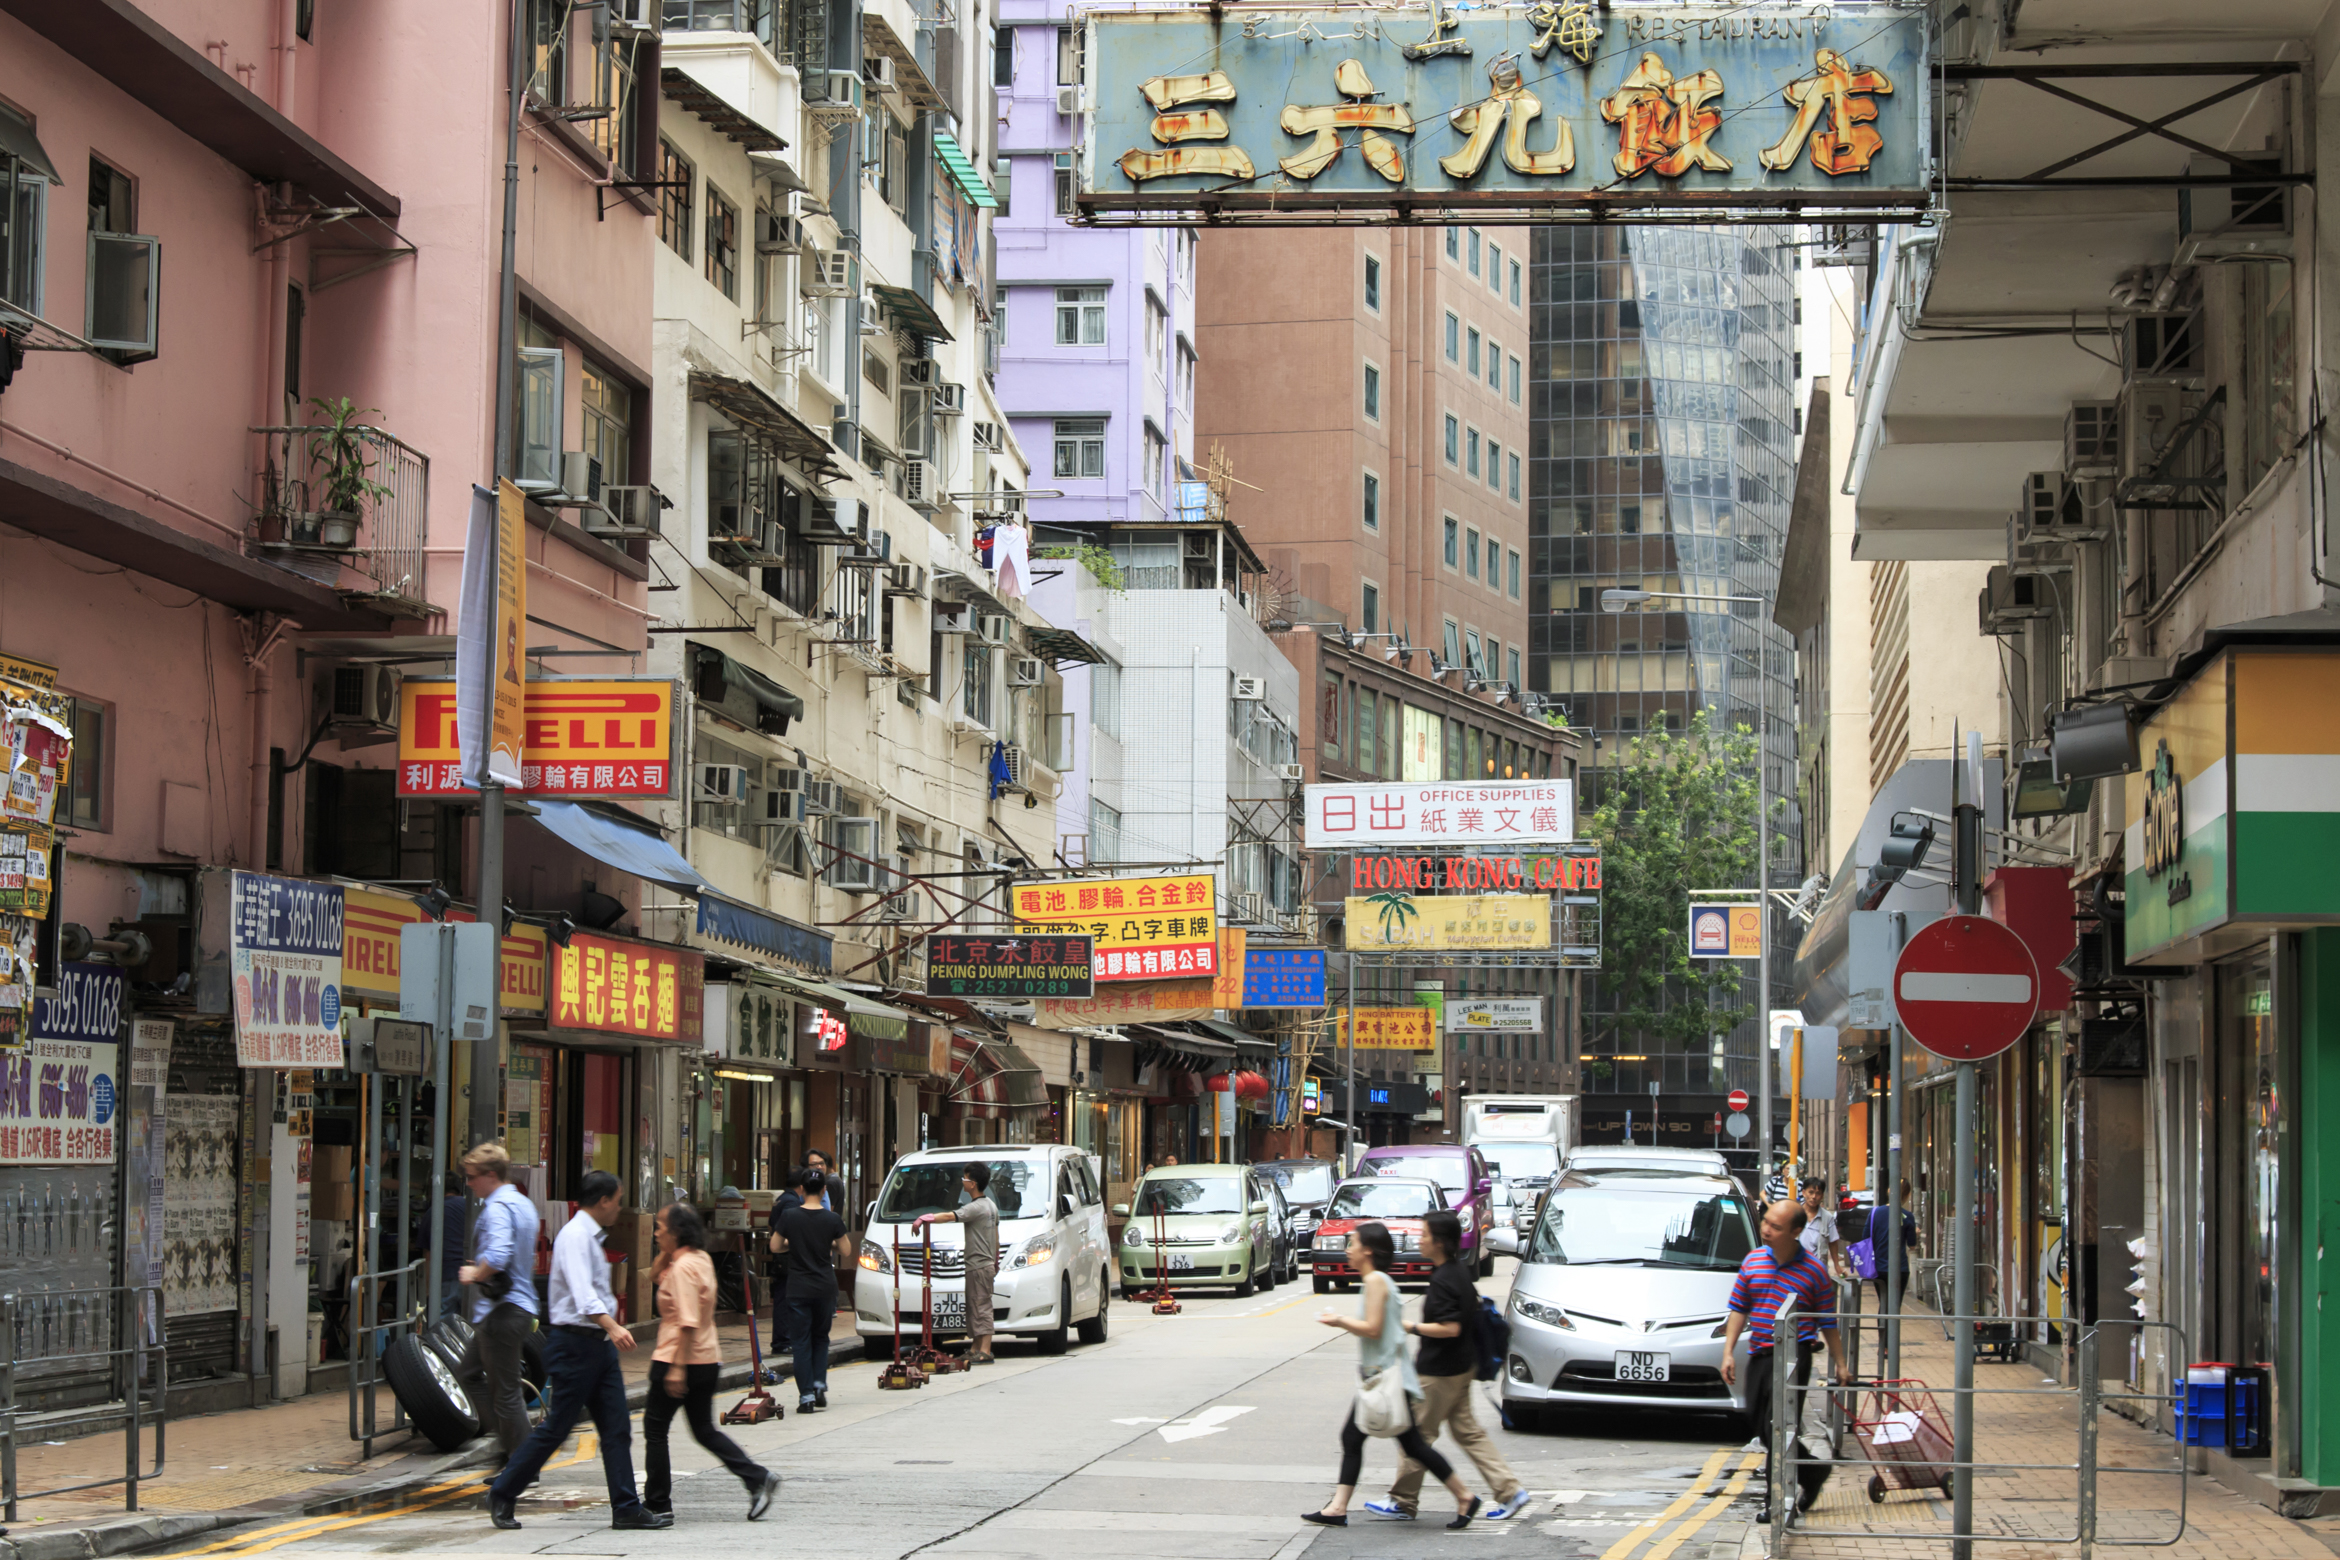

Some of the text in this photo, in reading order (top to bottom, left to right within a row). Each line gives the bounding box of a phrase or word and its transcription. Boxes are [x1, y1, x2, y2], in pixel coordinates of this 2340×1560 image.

[1115, 48, 1894, 181] 三六九飯店
[1420, 788, 1556, 802] OFFICE SUPPLIES
[1322, 793, 1406, 833] 日出
[1420, 806, 1559, 834] 紙業文儀
[1353, 857, 1602, 890] HONG KONG CAFE
[286, 888, 314, 948] 3695
[316, 893, 343, 951] 0168
[1360, 924, 1435, 945] SABAH
[1497, 933, 1532, 944] Cuisine
[933, 939, 1089, 965] 北京水餃皇
[931, 965, 1089, 980] PEKING DUMPLING WONG
[1025, 981, 1069, 994] 0289
[82, 973, 121, 1037] 0168
[322, 990, 338, 1022] 售
[1458, 1003, 1488, 1015] LEE MAN
[1468, 1013, 1491, 1024] PLATE
[1669, 1122, 1691, 1132] 90
[942, 1293, 958, 1303] JU
[933, 1302, 966, 1313] 3706
[1631, 1352, 1654, 1367] ND
[1619, 1365, 1665, 1381] 6656
